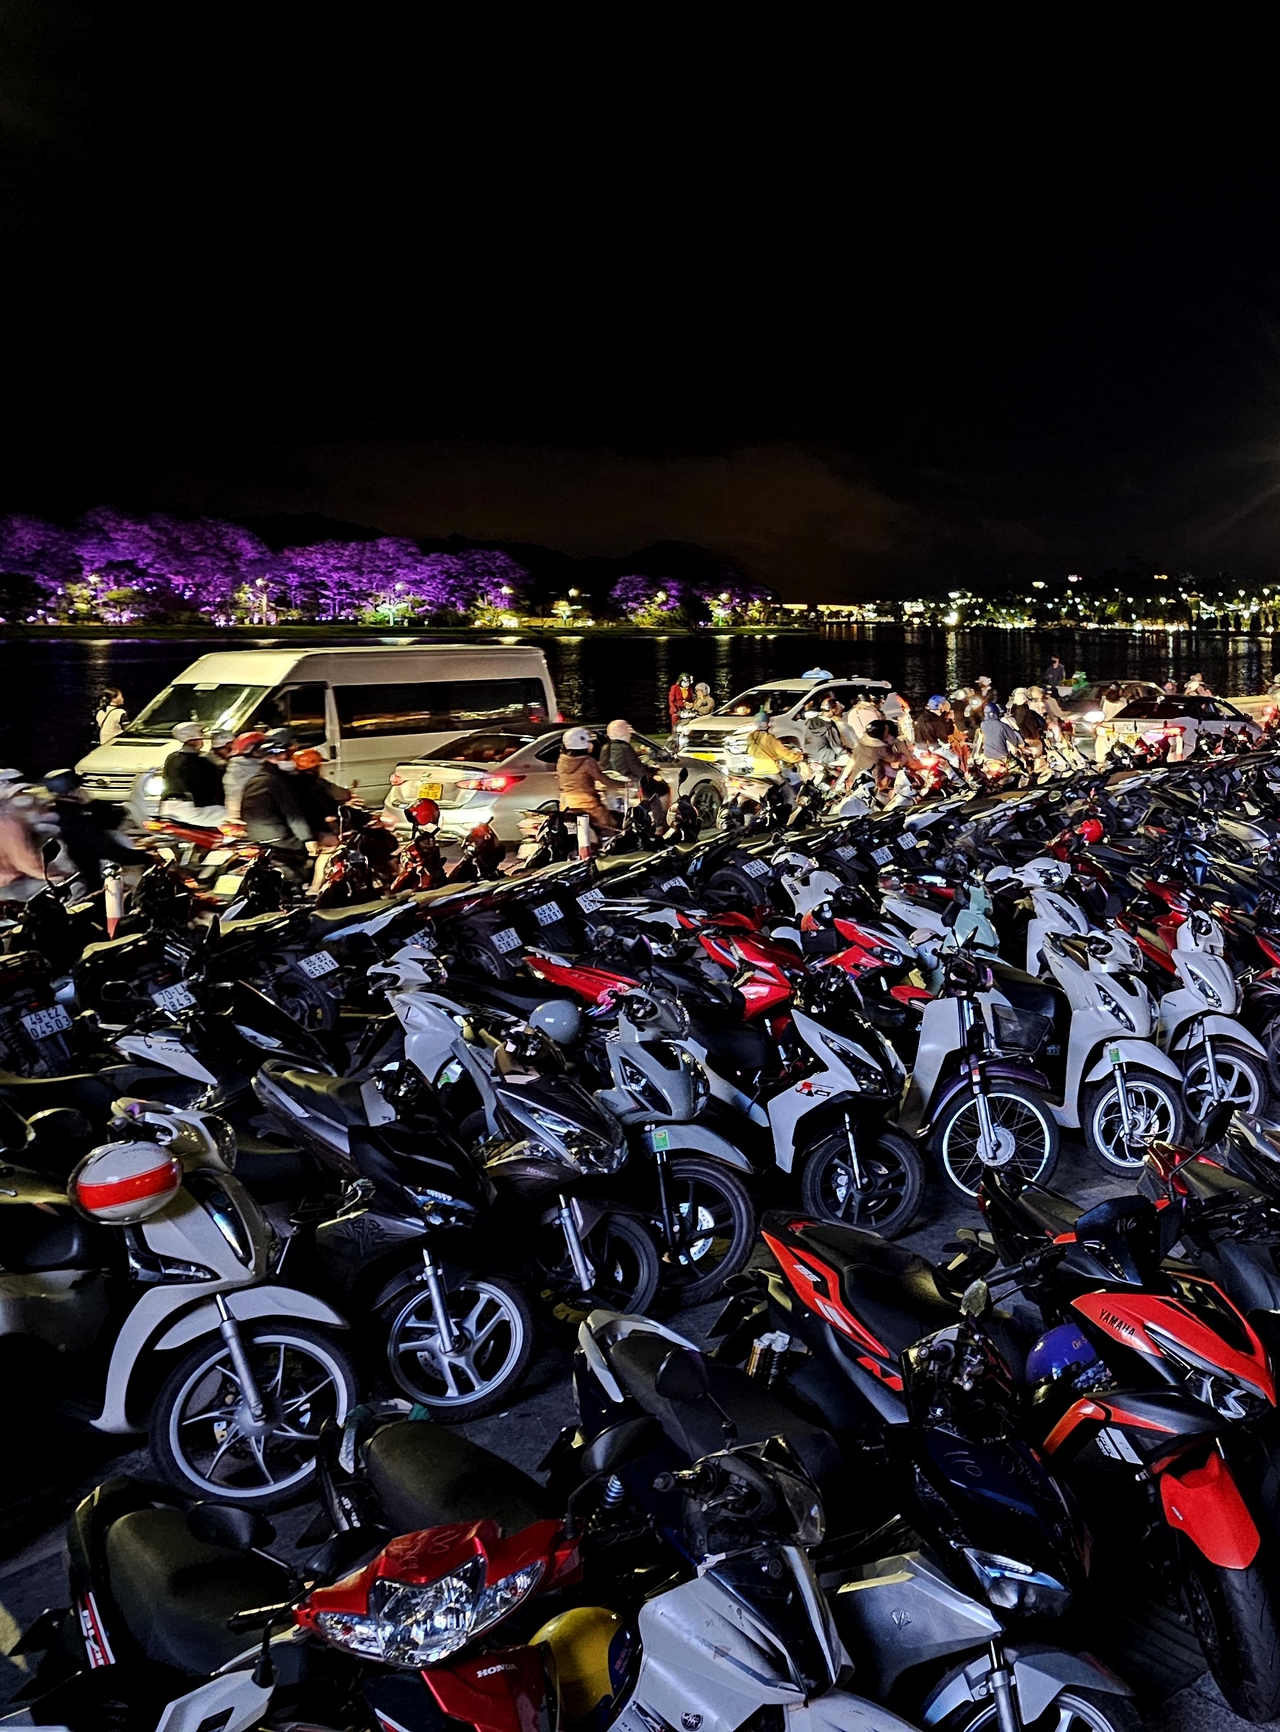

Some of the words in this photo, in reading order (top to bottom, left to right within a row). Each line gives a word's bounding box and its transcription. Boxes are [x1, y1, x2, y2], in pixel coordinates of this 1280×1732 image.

[526, 1166, 559, 1180] HONDA
[1099, 1308, 1136, 1337] YAMAHA
[476, 1663, 518, 1679] HONDA
